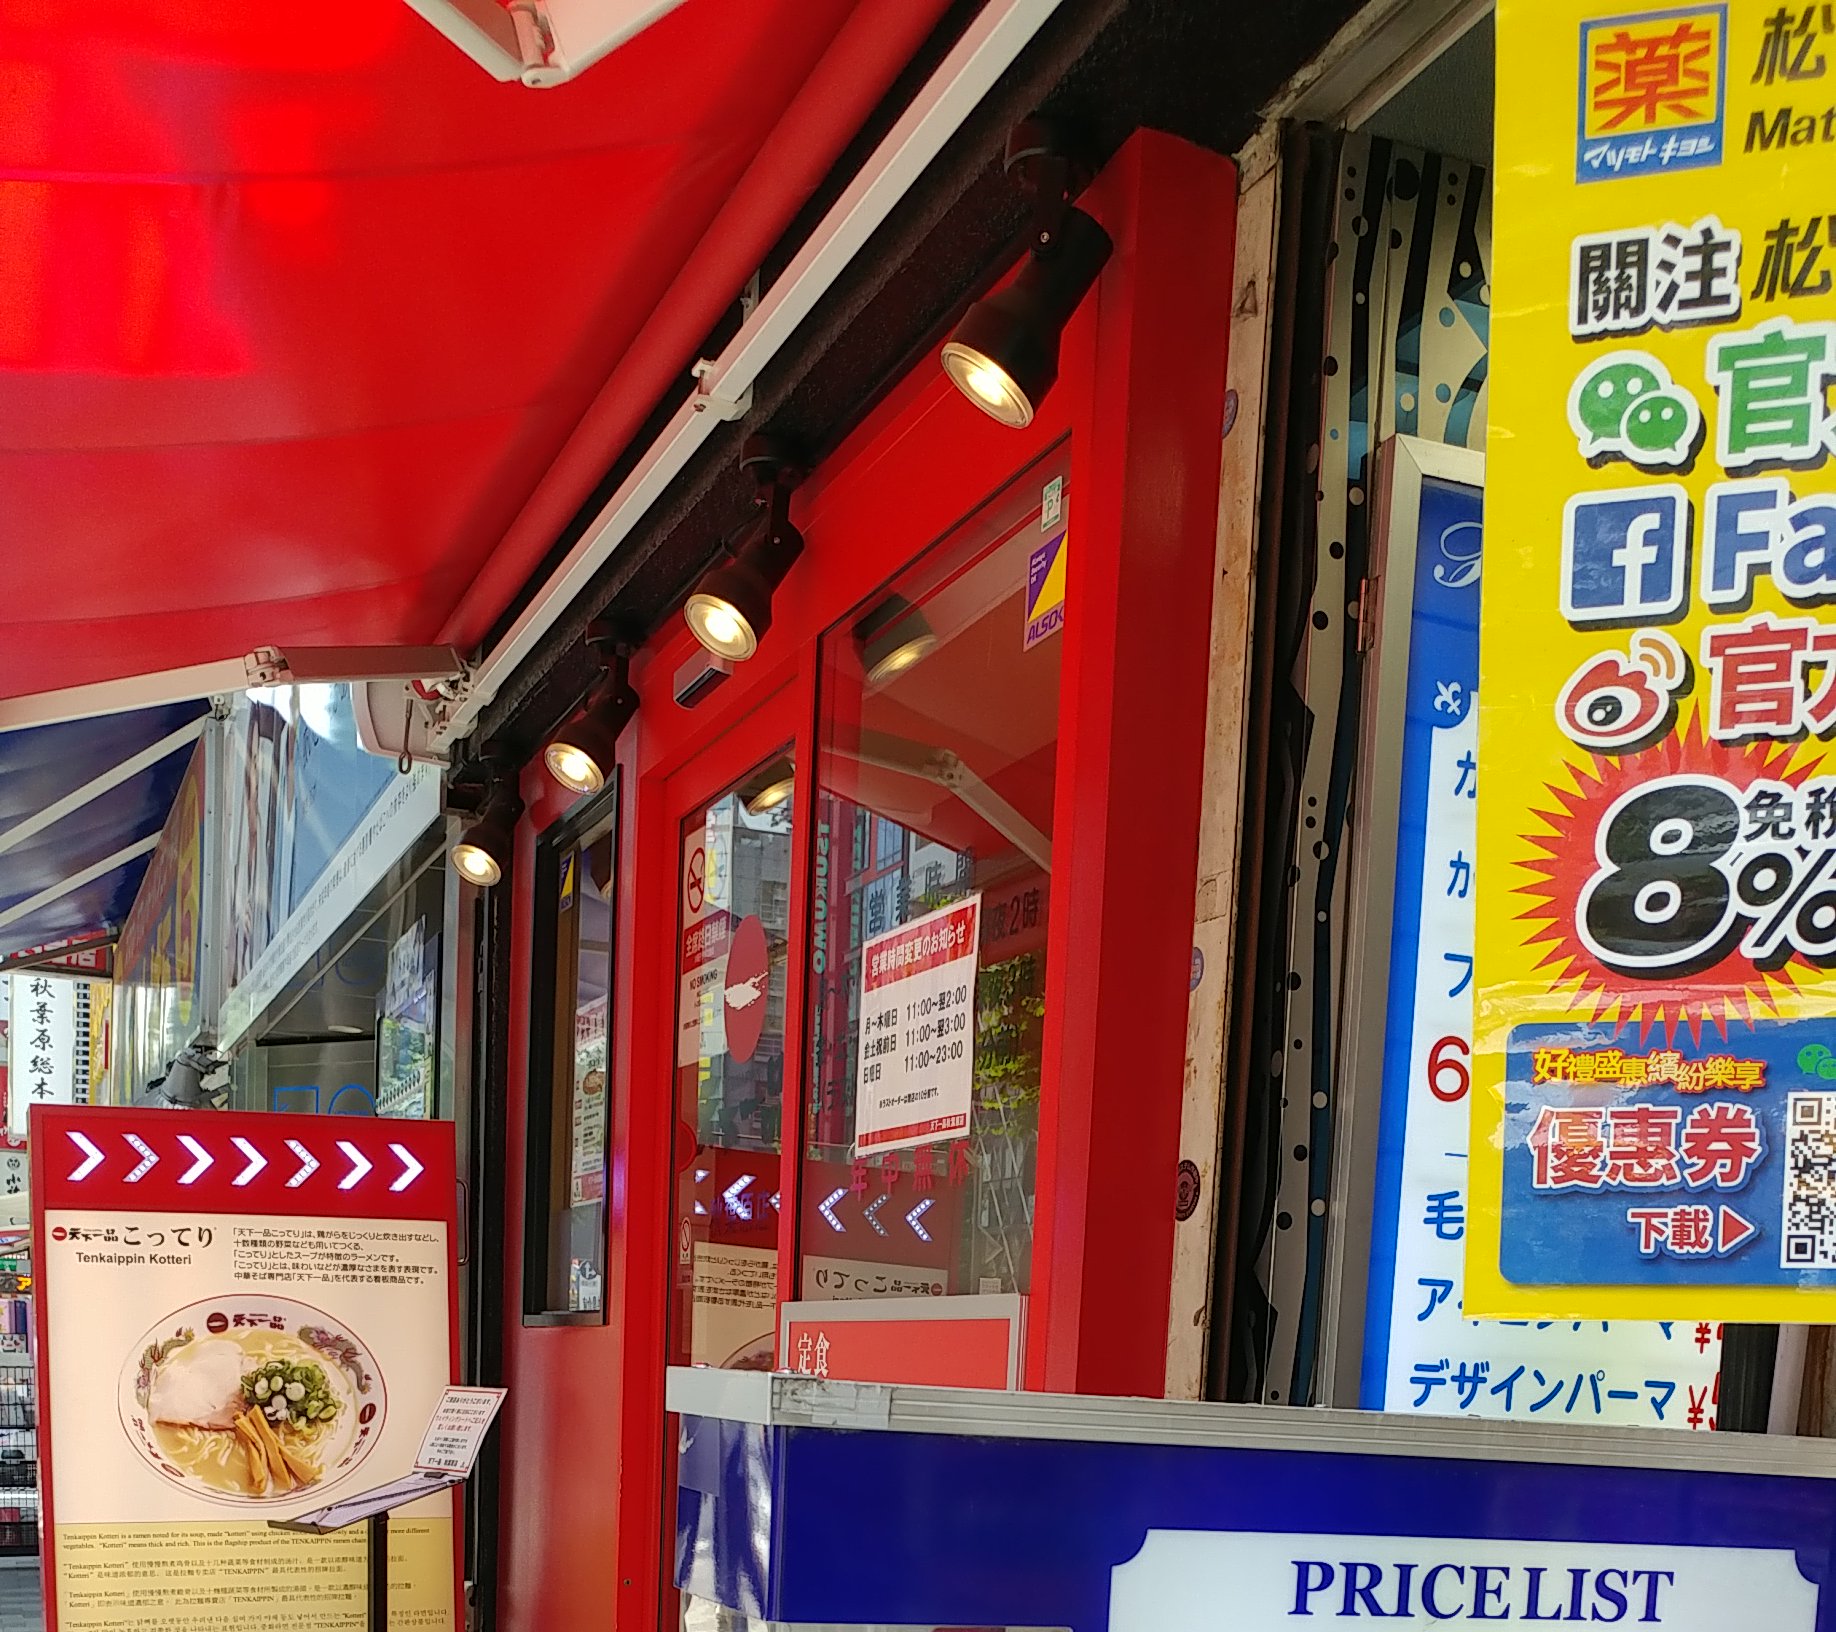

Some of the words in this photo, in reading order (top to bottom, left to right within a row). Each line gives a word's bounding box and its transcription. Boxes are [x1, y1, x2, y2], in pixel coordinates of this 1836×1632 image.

[1750, 4, 1836, 86] 松
[1577, 226, 1732, 326] 關注
[1750, 214, 1836, 302] 松
[1717, 330, 1836, 455] 官
[871, 921, 967, 979] 営業時間変更のお知らせ
[1530, 1106, 1759, 1185] 優惠券
[75, 1251, 145, 1266] Tenkaippin
[149, 1253, 192, 1265] Kotteri
[1630, 1208, 1710, 1250] 下載
[797, 1331, 831, 1378] 定食
[1409, 1358, 1676, 1422] デザインパーマ
